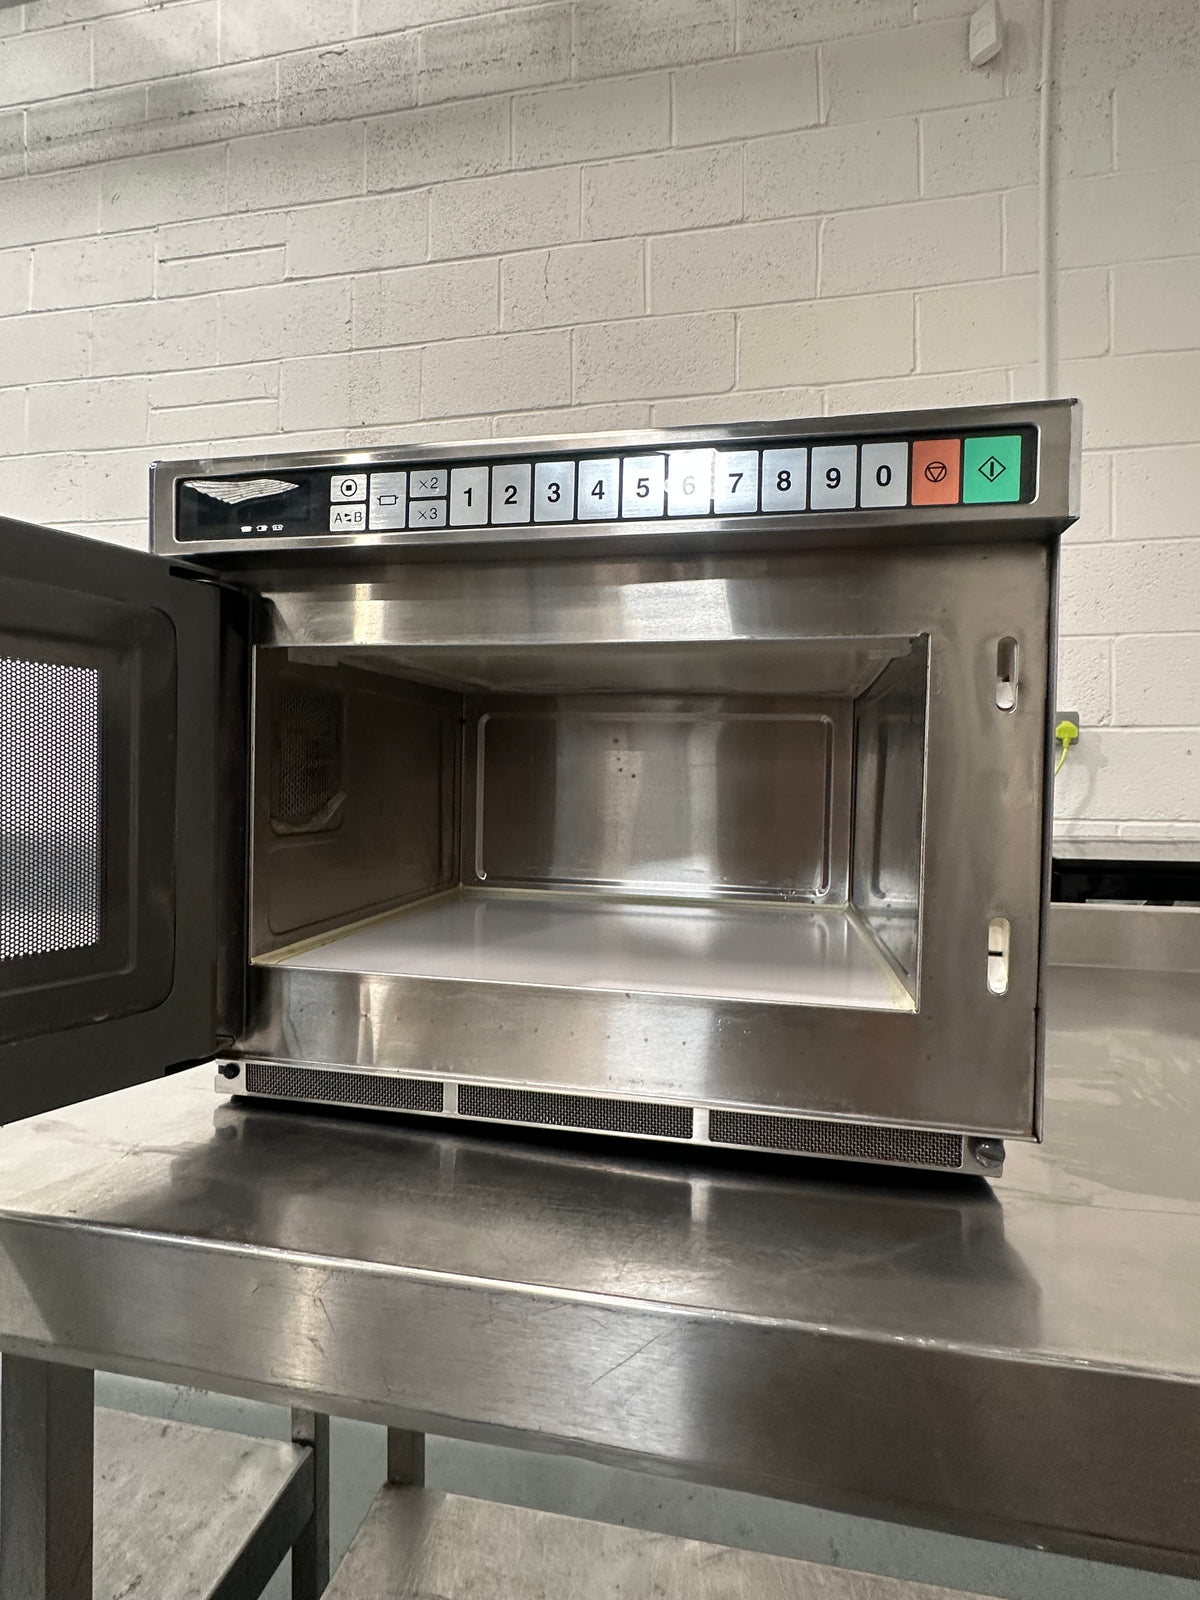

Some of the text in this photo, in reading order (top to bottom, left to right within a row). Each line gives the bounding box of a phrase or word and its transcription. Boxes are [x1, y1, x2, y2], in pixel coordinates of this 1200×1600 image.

[463, 464, 892, 507] 1 2 3 4 5 6 7 8 9 0
[334, 511, 363, 524] A B
